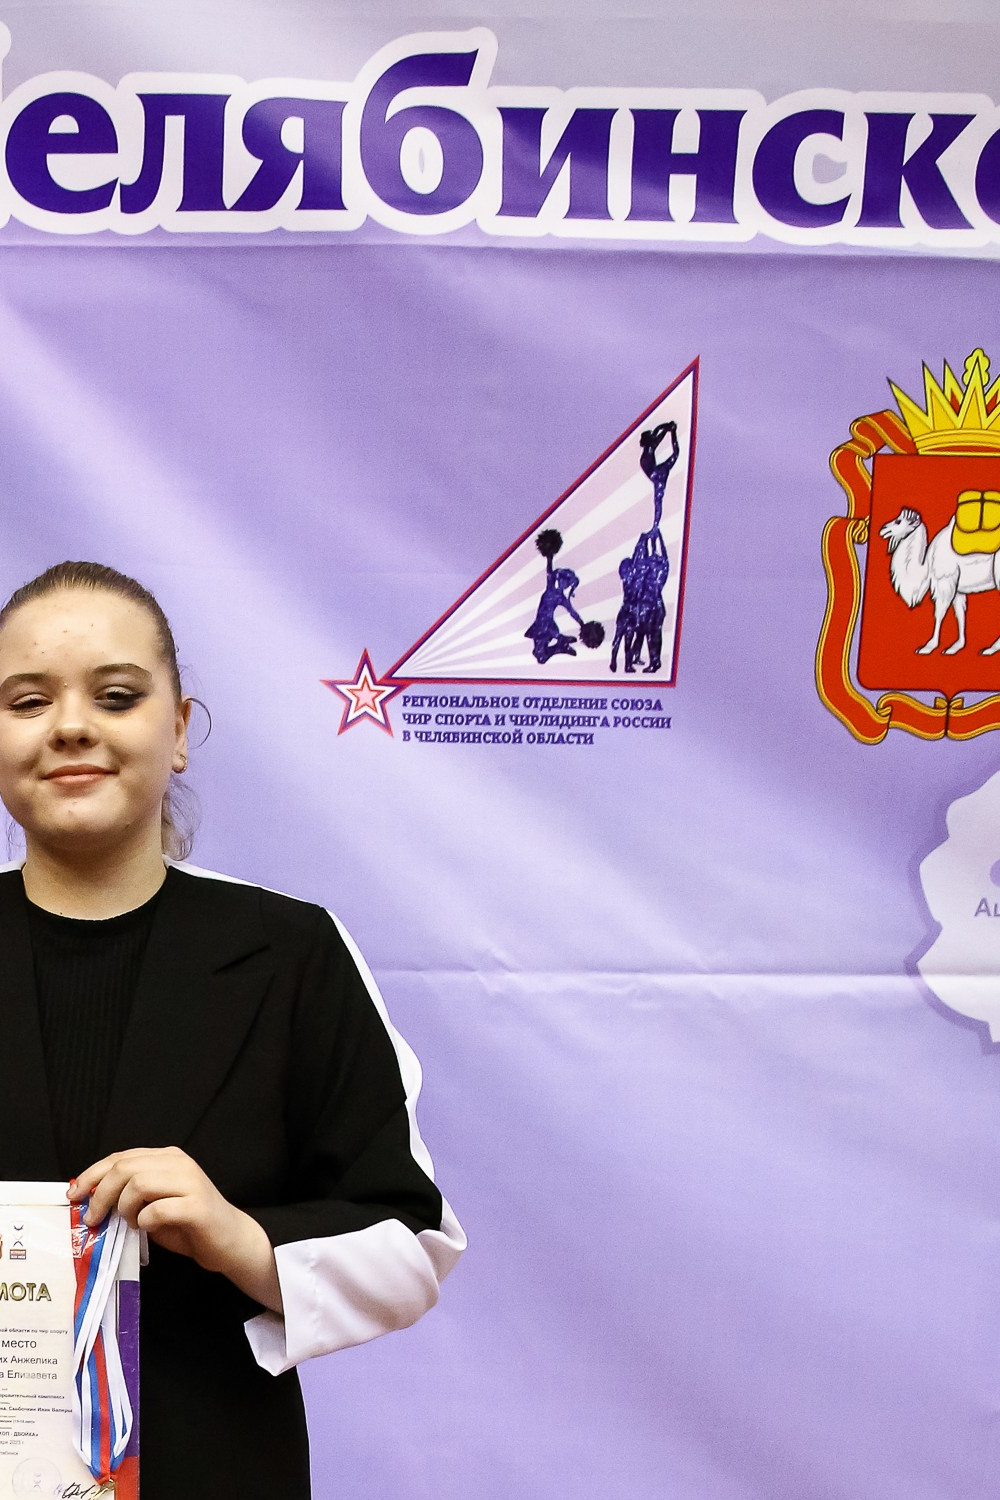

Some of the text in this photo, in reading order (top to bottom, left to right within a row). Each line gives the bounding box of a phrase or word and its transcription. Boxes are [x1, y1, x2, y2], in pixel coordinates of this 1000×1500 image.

[402, 695, 664, 711] РЕГИОНАЛЬНОЕ ОТДЕЛЕНИЕ СОЮЗА
[402, 712, 672, 729] ЧИР СПОРТА И ЧИРЛИДИНГА РОССИИ
[402, 729, 595, 745] В ЧЕЛЯБИНСКОЙ ОБЛАСТИ
[1, 1339, 37, 1349] место
[10, 1355, 58, 1365] Анжелика
[7, 1370, 58, 1380] Елизавета
